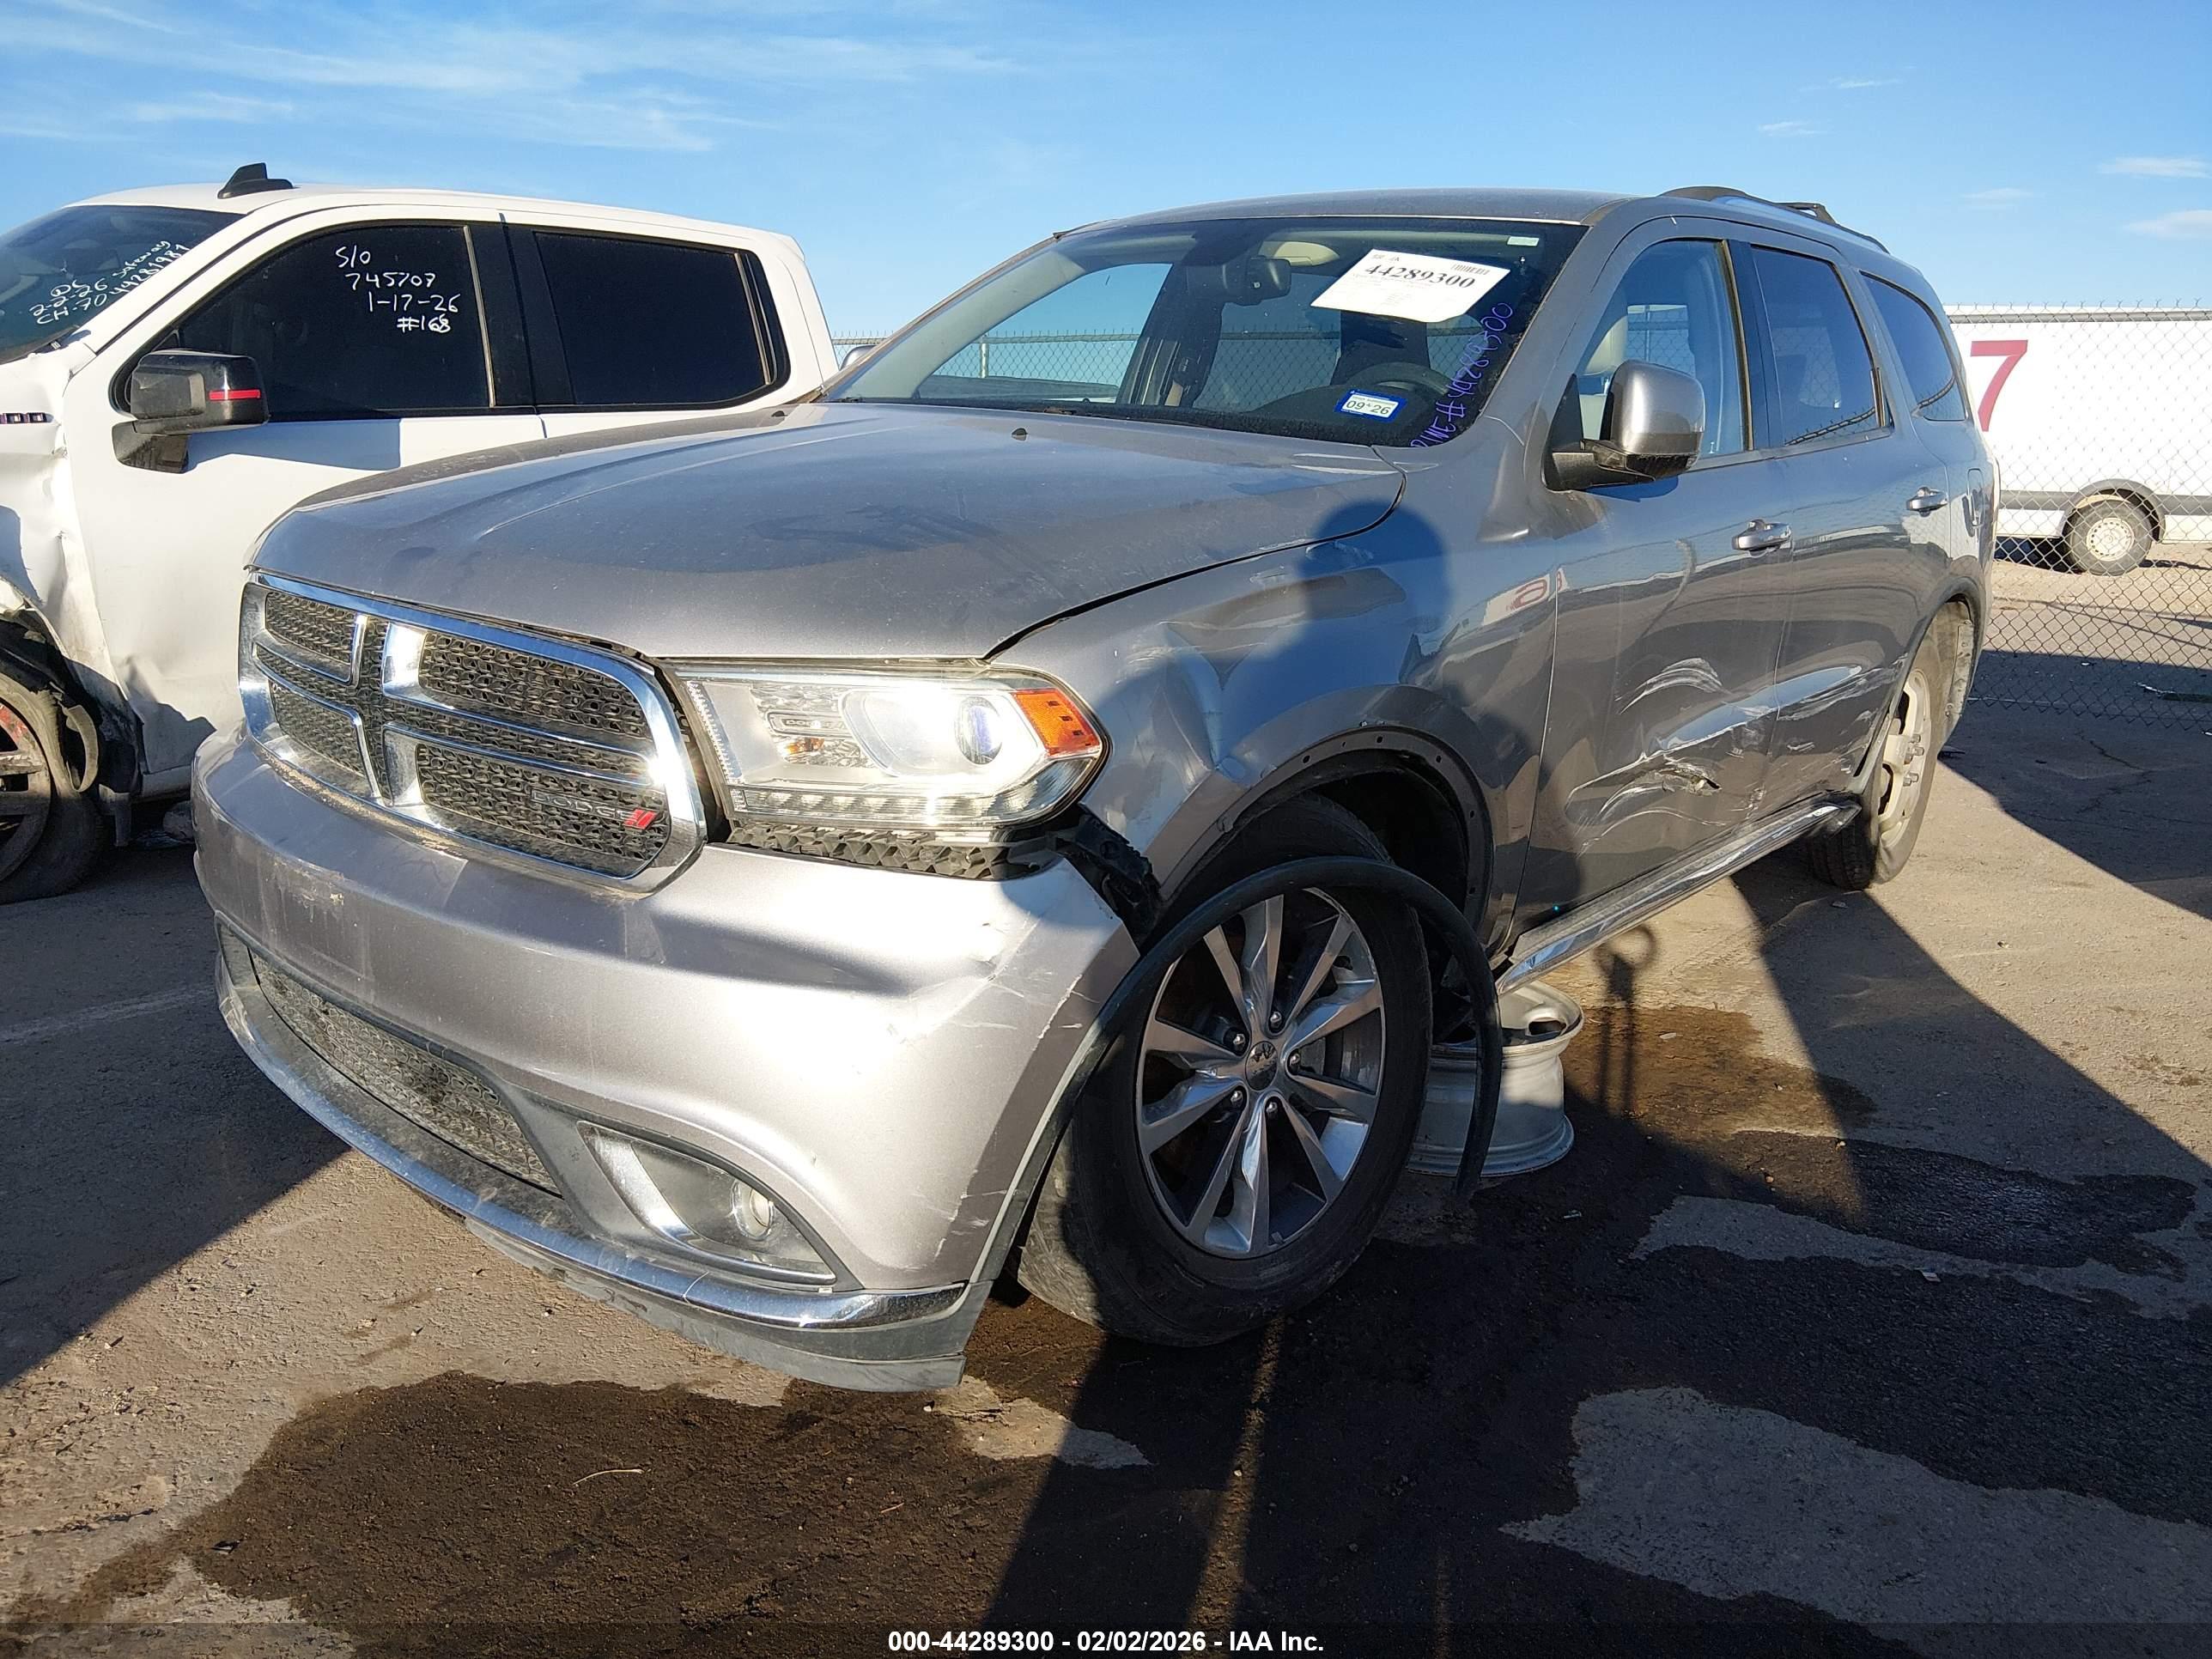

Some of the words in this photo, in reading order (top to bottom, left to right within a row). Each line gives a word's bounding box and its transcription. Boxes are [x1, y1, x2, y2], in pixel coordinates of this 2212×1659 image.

[345, 272, 435, 290] 745707
[1364, 264, 1475, 289] 44289300
[29, 277, 108, 317] 2-2-26
[37, 293, 107, 325] CH-70
[368, 291, 461, 313] 1-17-26
[397, 313, 451, 333] #168
[1970, 339, 2028, 432] 7
